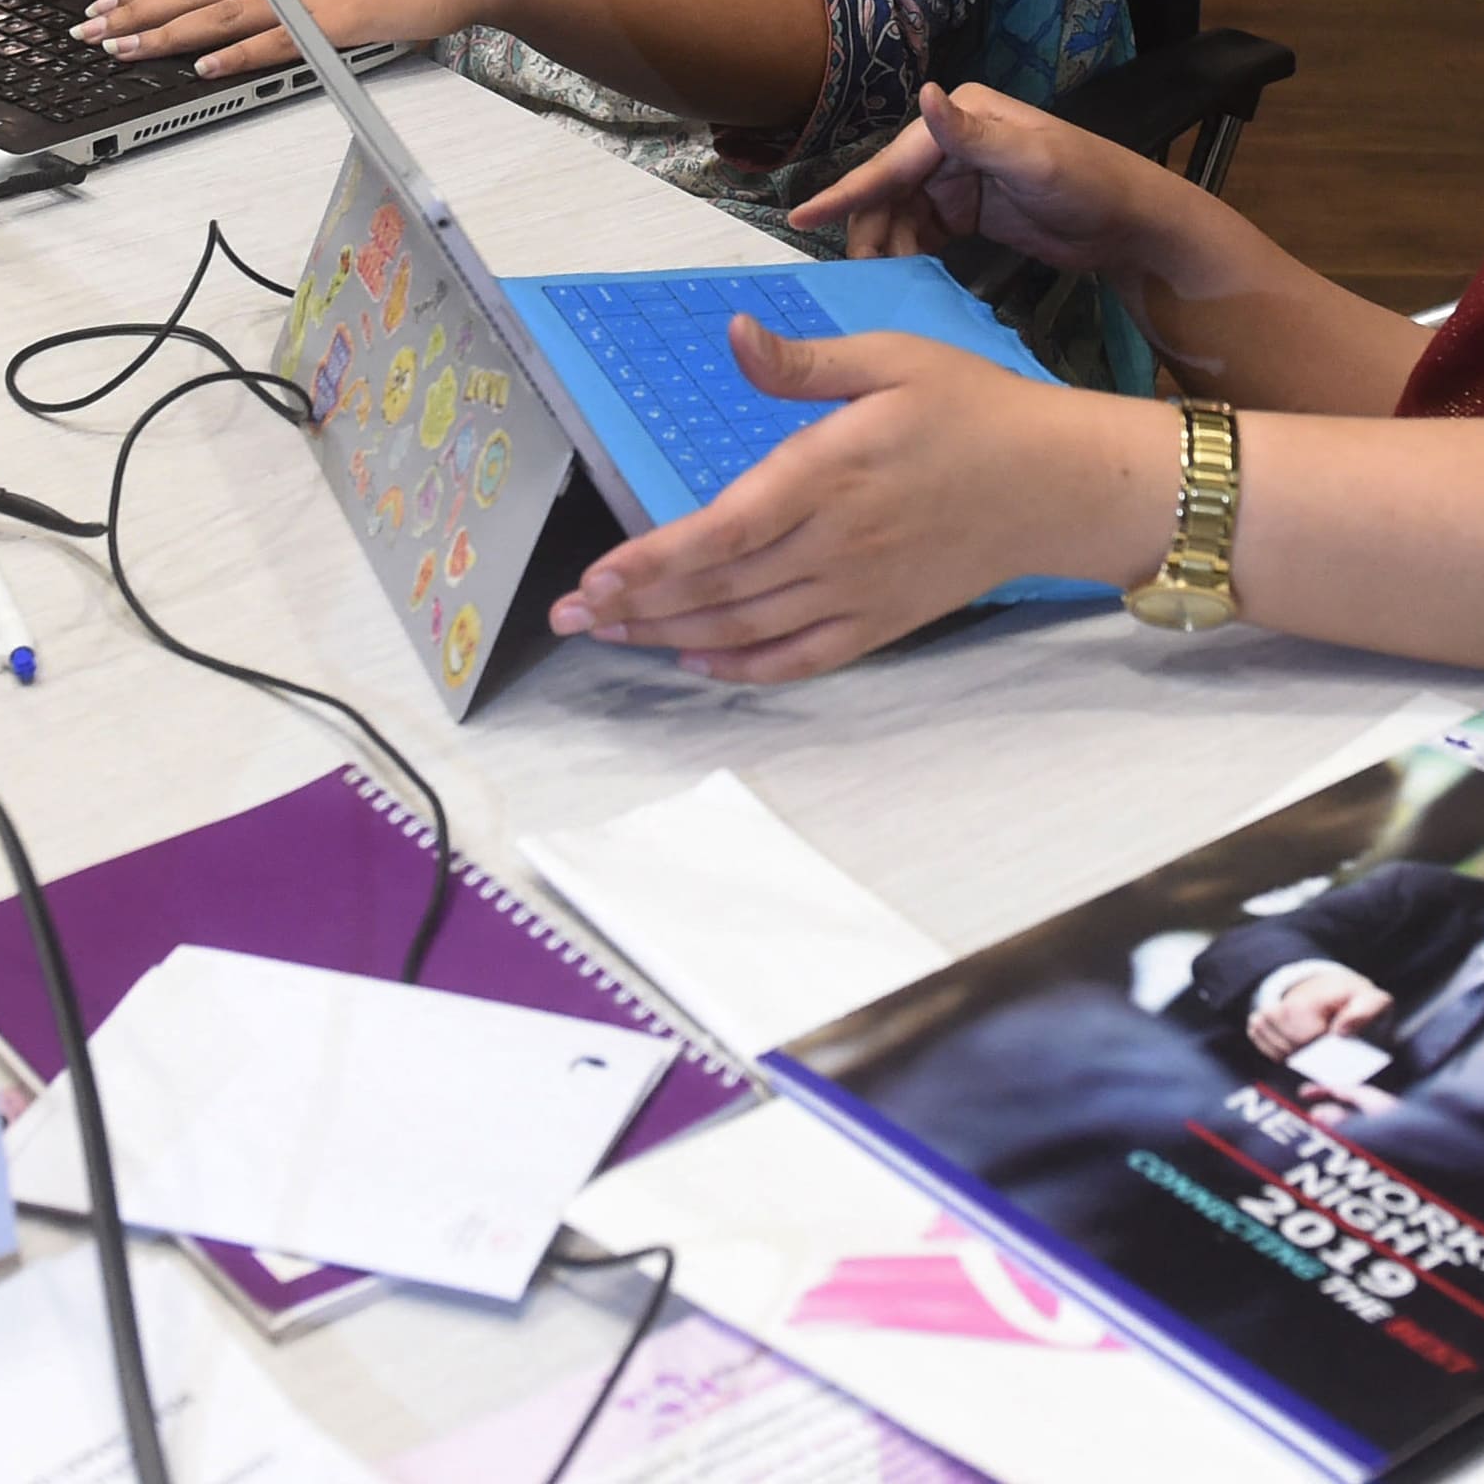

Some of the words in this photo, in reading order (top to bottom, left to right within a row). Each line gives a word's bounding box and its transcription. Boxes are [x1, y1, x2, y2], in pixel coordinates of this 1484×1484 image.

[1126, 1148, 1327, 1282] CONNECTING
[1319, 1274, 1396, 1325] THE
[1236, 1184, 1417, 1299] 2019
[1282, 1161, 1464, 1272] NIGHT
